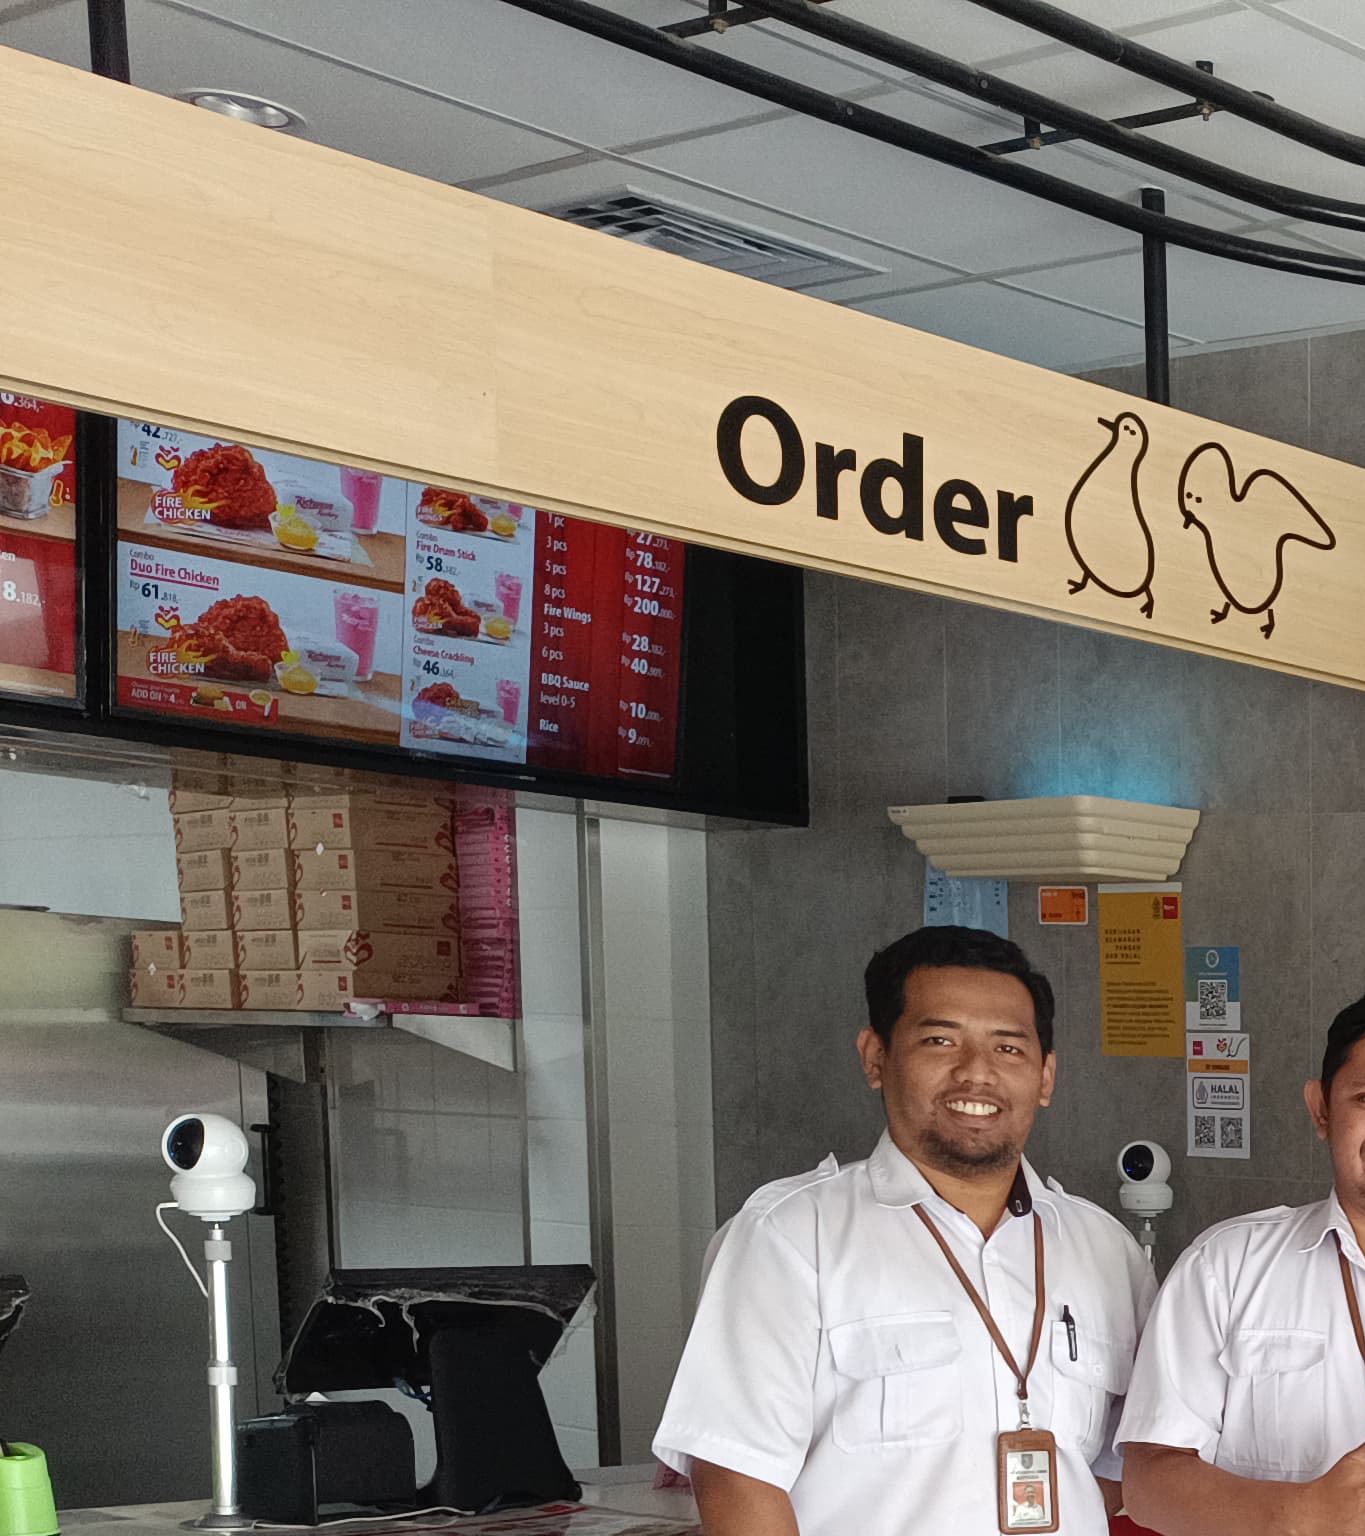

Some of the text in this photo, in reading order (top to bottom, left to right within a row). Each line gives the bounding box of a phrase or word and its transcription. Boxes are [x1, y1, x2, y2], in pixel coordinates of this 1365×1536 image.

[716, 395, 1034, 563] Order
[155, 496, 182, 508] FIRE
[154, 507, 211, 520] CHICKEN
[416, 540, 431, 552] Fire
[553, 540, 568, 552] pcs
[130, 559, 220, 586] Duo Fire Chicken
[552, 564, 567, 575] pcs
[551, 588, 566, 600] pcs
[543, 603, 592, 625] Fire Wings
[550, 626, 565, 638] pcs
[150, 652, 177, 663] FIRE
[549, 650, 564, 661] pcs
[149, 662, 205, 675] CHICKEN
[541, 673, 590, 691] BBQ Sauce
[539, 719, 560, 732] Rice
[1209, 1083, 1240, 1095] HALAL
